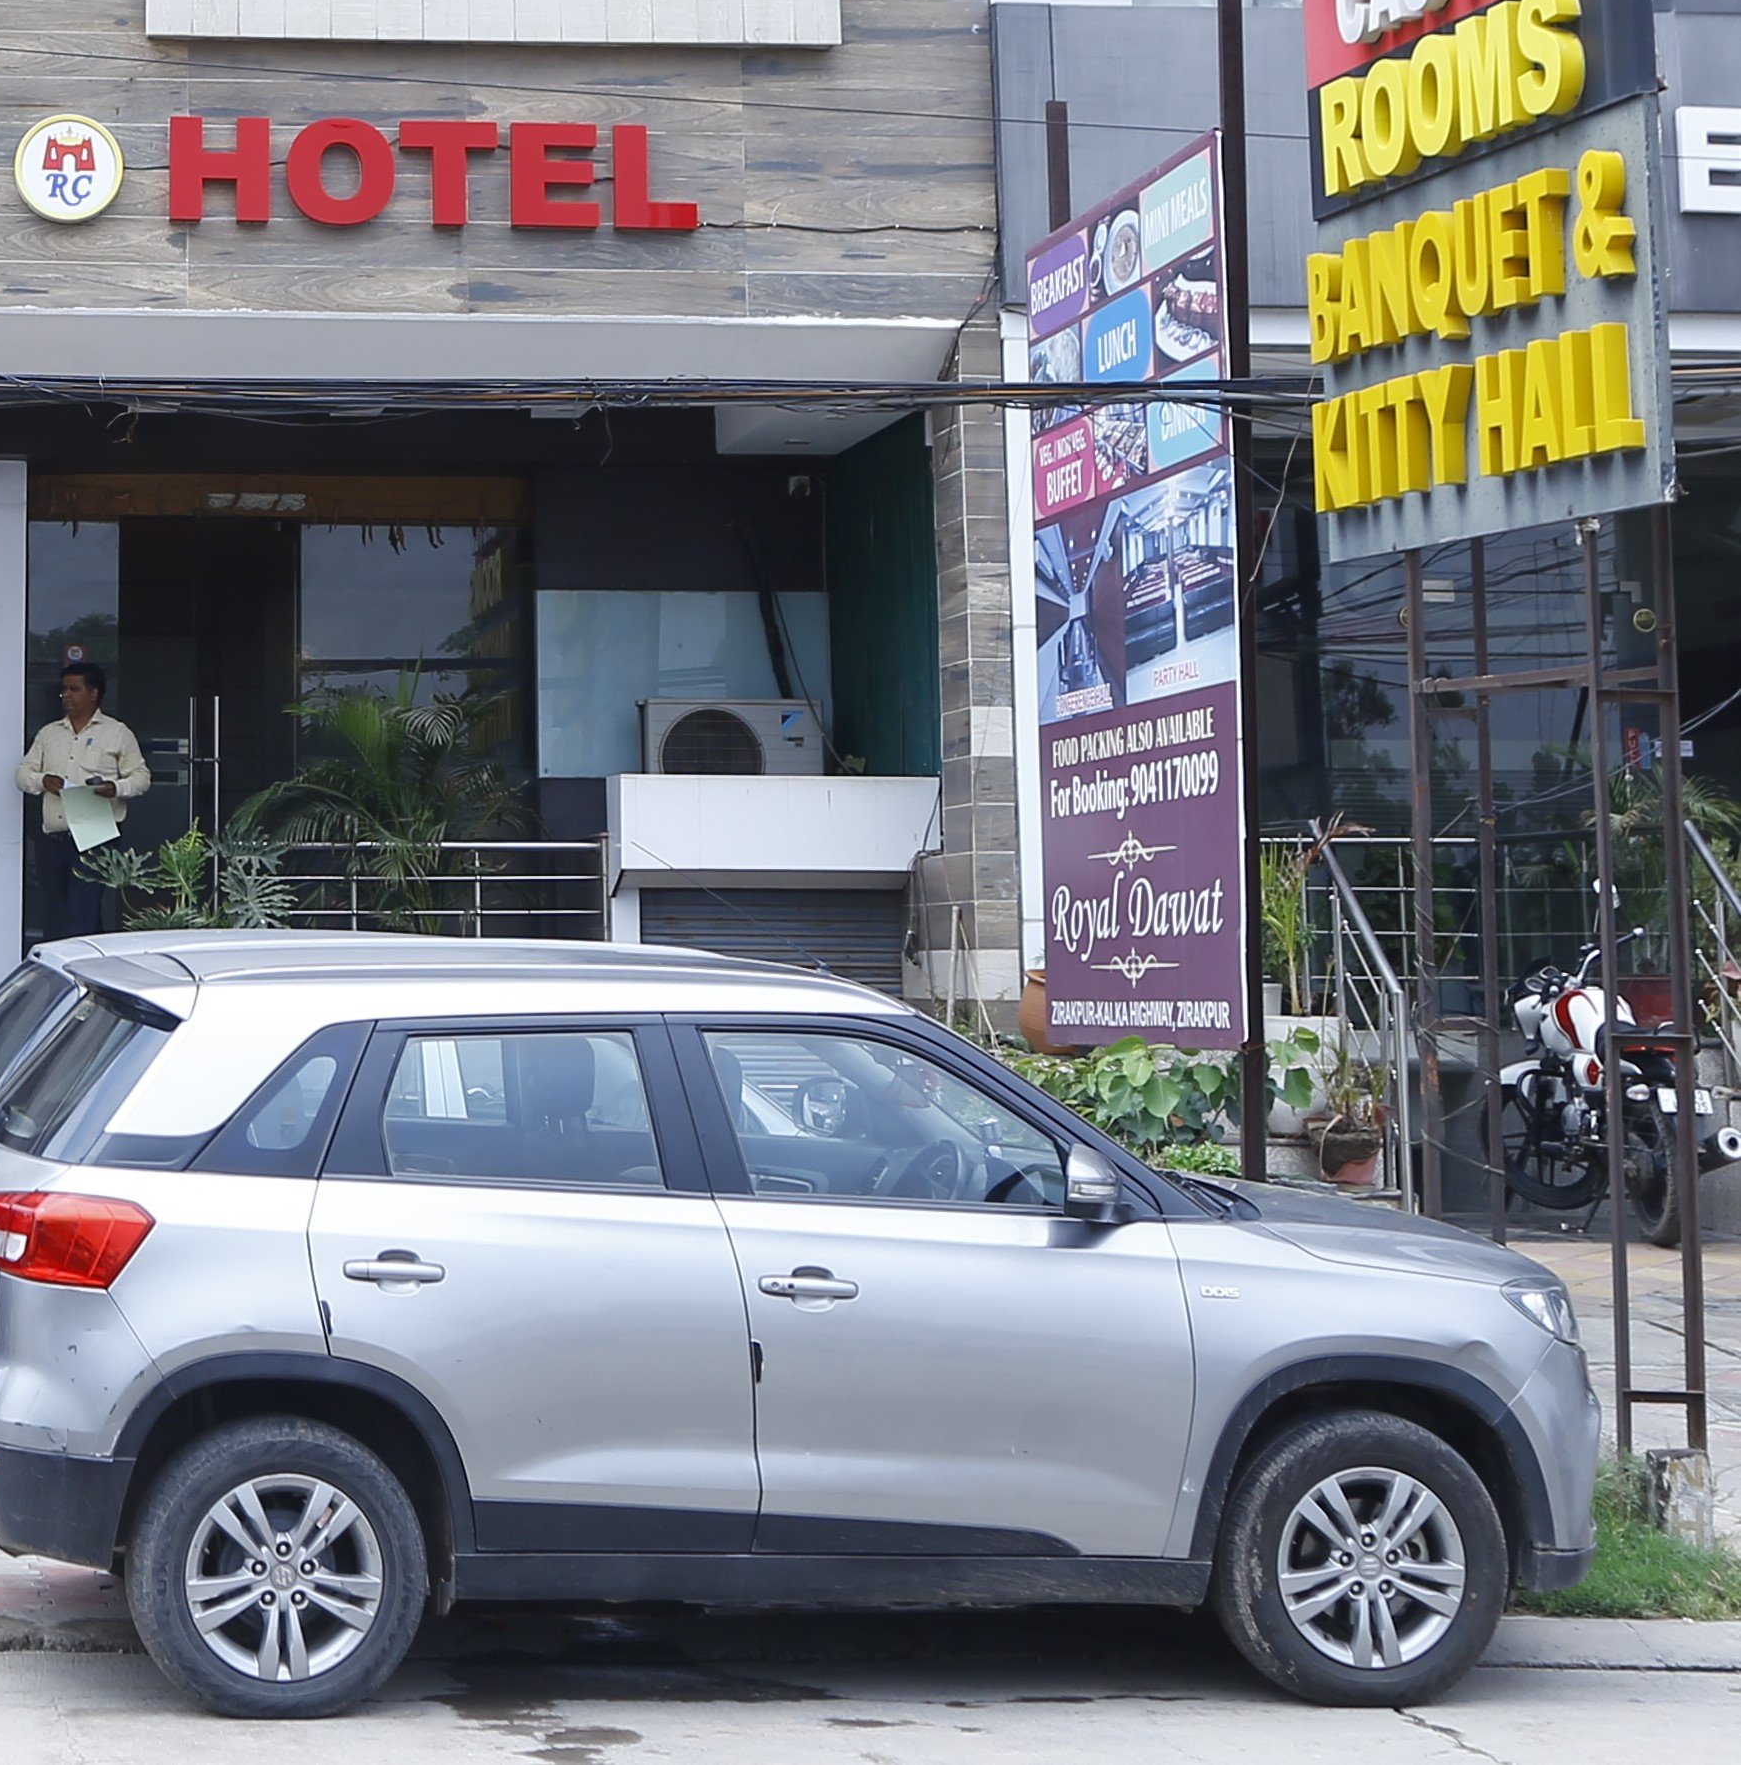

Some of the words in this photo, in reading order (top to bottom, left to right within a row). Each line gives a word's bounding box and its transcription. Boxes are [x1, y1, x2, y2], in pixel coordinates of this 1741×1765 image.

[45, 173, 94, 206] RC
[169, 116, 699, 230] HOTEL
[1144, 197, 1169, 249] MINI
[1170, 177, 1208, 234] MEALS
[1030, 253, 1087, 317] BREAKFAST
[1306, 167, 1570, 366] BANQUET
[1573, 149, 1637, 279] &
[1097, 318, 1138, 374] LUNCH
[1311, 363, 1473, 514] KITTY
[1475, 322, 1647, 476] HALL
[1046, 459, 1084, 508] BUFFET
[1153, 665, 1178, 689] PARTY
[1178, 659, 1200, 682] HALL
[1051, 735, 1080, 769] FOOD
[1080, 726, 1125, 764] PACKING
[1125, 719, 1154, 754] ALSO
[1155, 707, 1216, 748] AVAILABLE
[1050, 779, 1072, 818] For
[1072, 770, 1130, 821] Booking:
[1130, 750, 1219, 807] 9041170099
[1052, 870, 1125, 962] Royal
[1127, 878, 1224, 938] Dawat
[1129, 1001, 1176, 1032] HIGHWAY,
[1176, 1001, 1231, 1029] ZIRAKPUR
